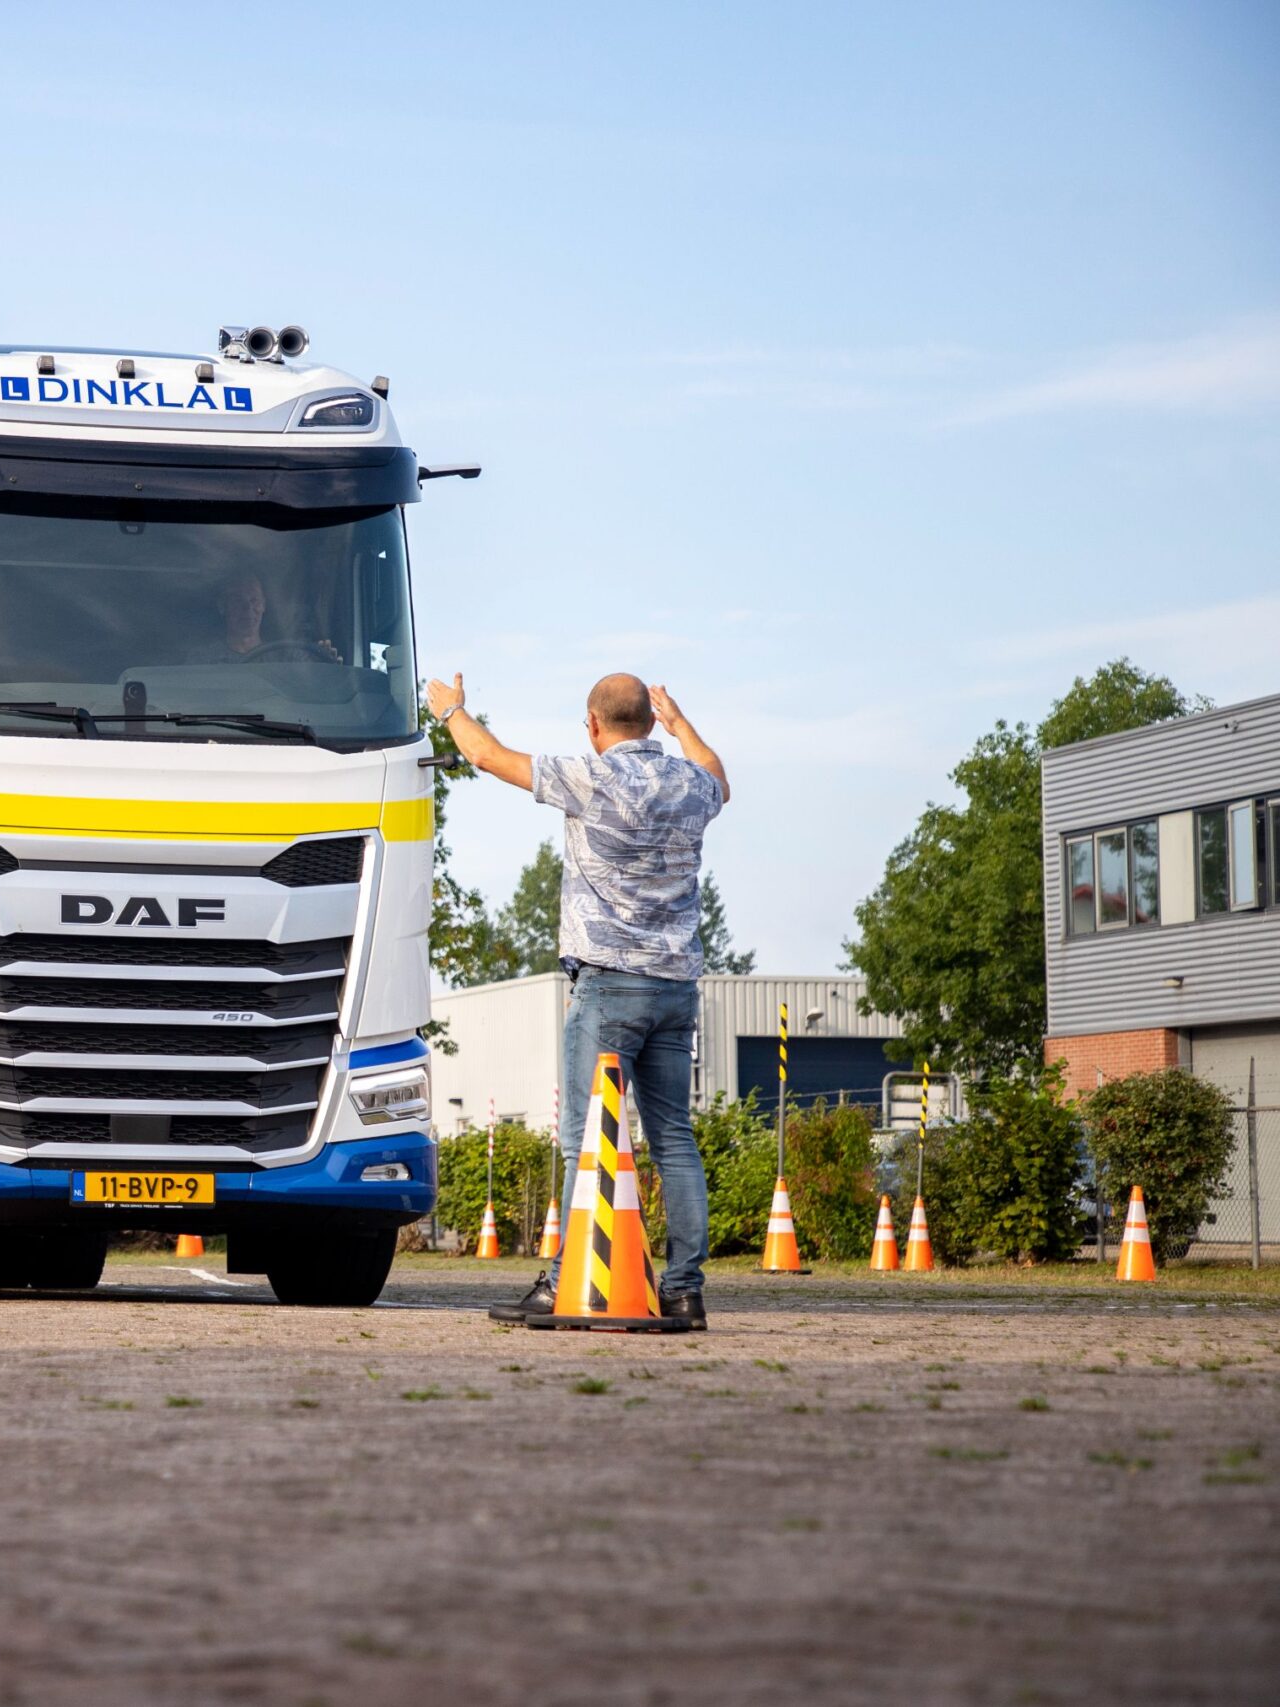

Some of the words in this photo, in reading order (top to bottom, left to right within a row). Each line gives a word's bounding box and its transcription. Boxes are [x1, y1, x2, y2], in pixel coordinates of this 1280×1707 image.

[38, 377, 218, 409] DINKLA
[60, 894, 226, 927] DAF
[212, 1012, 254, 1022] 450
[73, 1189, 84, 1197] NL
[100, 1176, 199, 1199] 11-BVP-9
